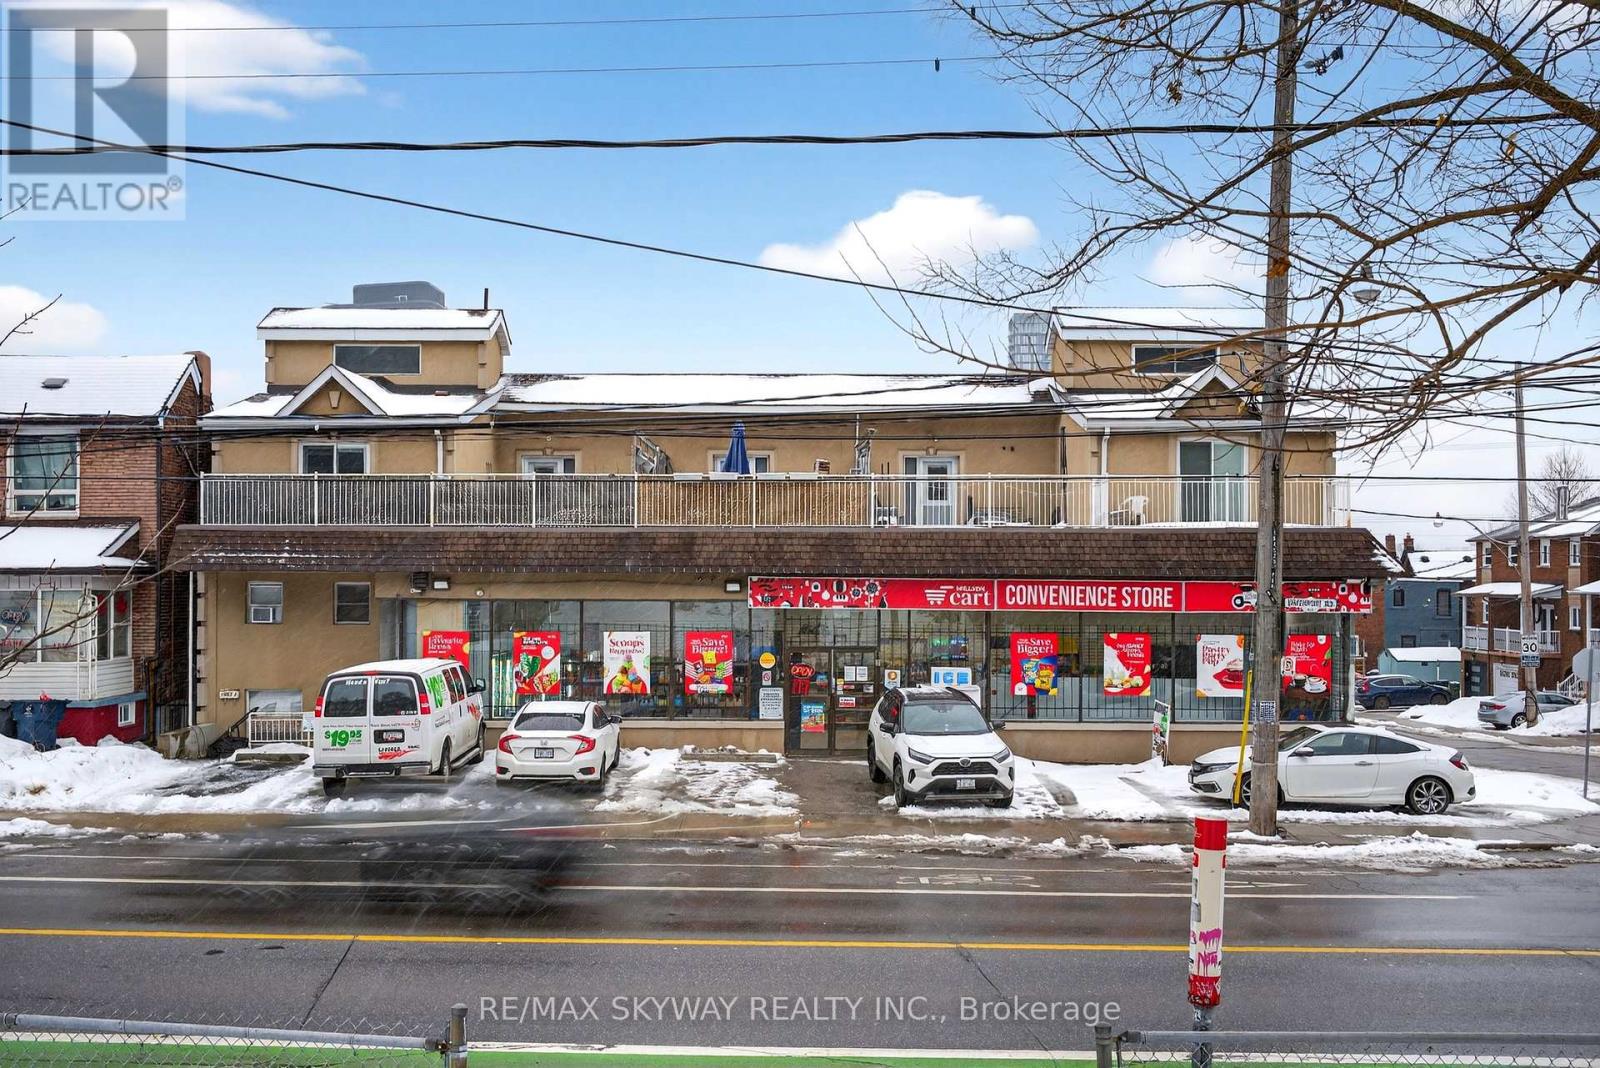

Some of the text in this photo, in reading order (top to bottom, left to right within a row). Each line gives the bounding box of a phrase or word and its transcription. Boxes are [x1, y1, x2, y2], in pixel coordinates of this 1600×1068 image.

[949, 591, 992, 606] cart
[1005, 584, 1174, 608] CONVENIENCE STORE
[1030, 638, 1052, 646] Save
[1522, 642, 1538, 653] 30
[1017, 644, 1053, 656] Bigger!
[791, 665, 813, 676] OPEN
[933, 671, 969, 684] ICE
